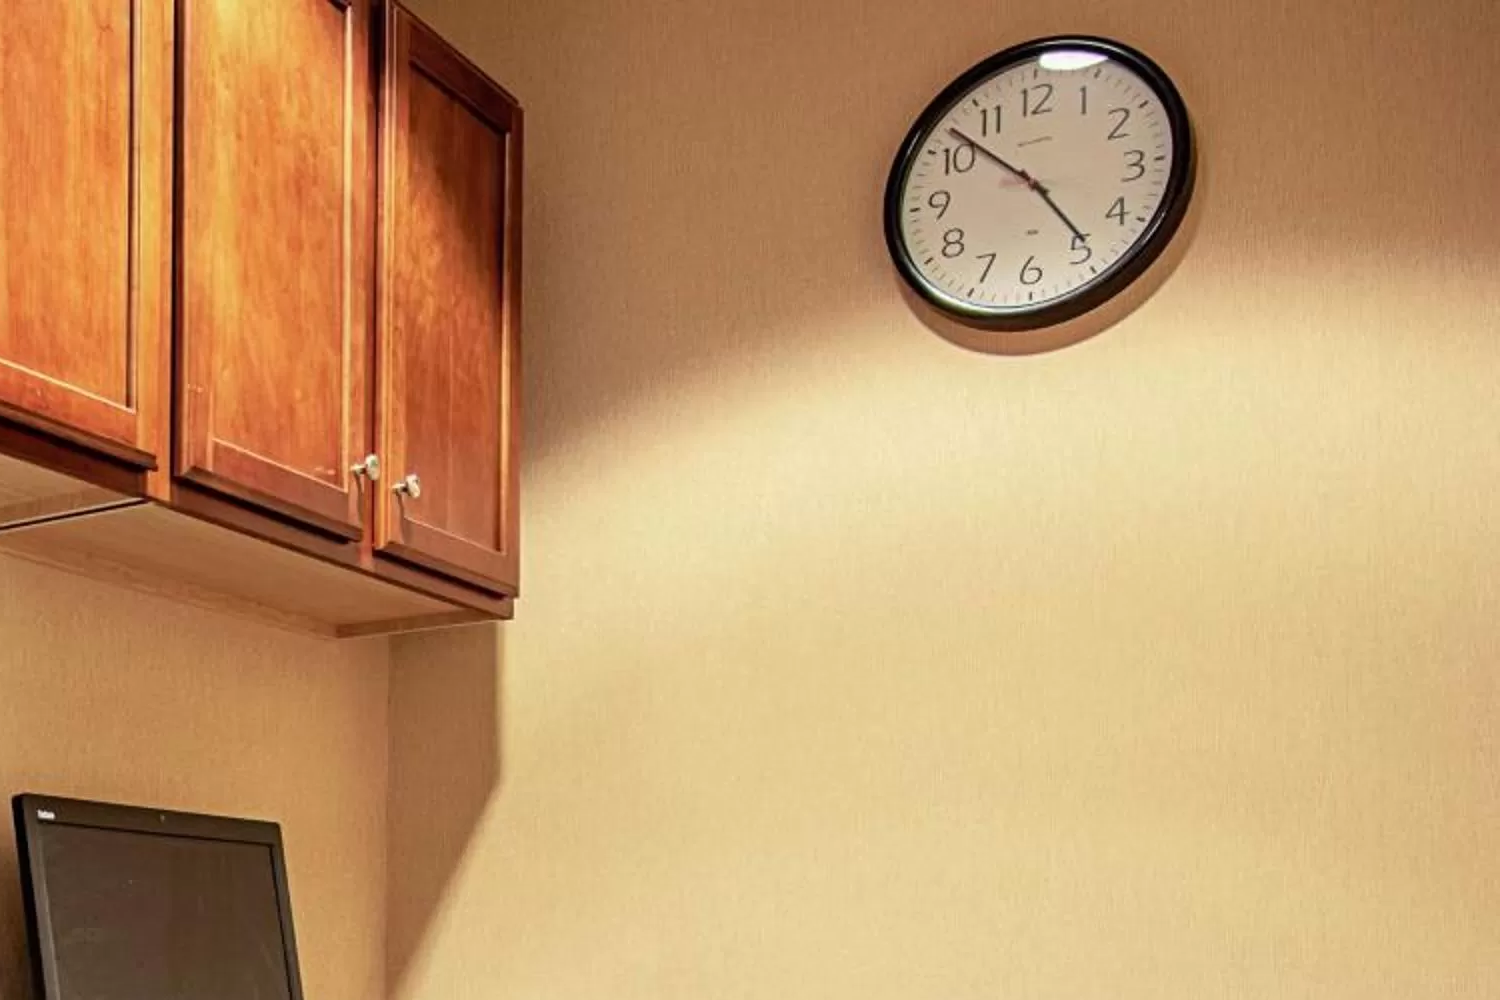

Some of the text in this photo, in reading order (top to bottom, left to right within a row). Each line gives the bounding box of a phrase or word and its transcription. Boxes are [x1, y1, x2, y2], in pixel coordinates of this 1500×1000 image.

[1020, 83, 1053, 118] 12
[1078, 85, 1087, 116] 1
[980, 105, 1002, 137] 11
[1107, 107, 1131, 140] 2
[942, 142, 976, 176] 10
[1121, 149, 1145, 182] 3
[928, 190, 951, 220] 9
[1105, 196, 1128, 226] 4
[941, 228, 965, 258] 8
[1069, 233, 1092, 265] 5
[976, 252, 997, 284] 7
[1019, 255, 1044, 285] 6
